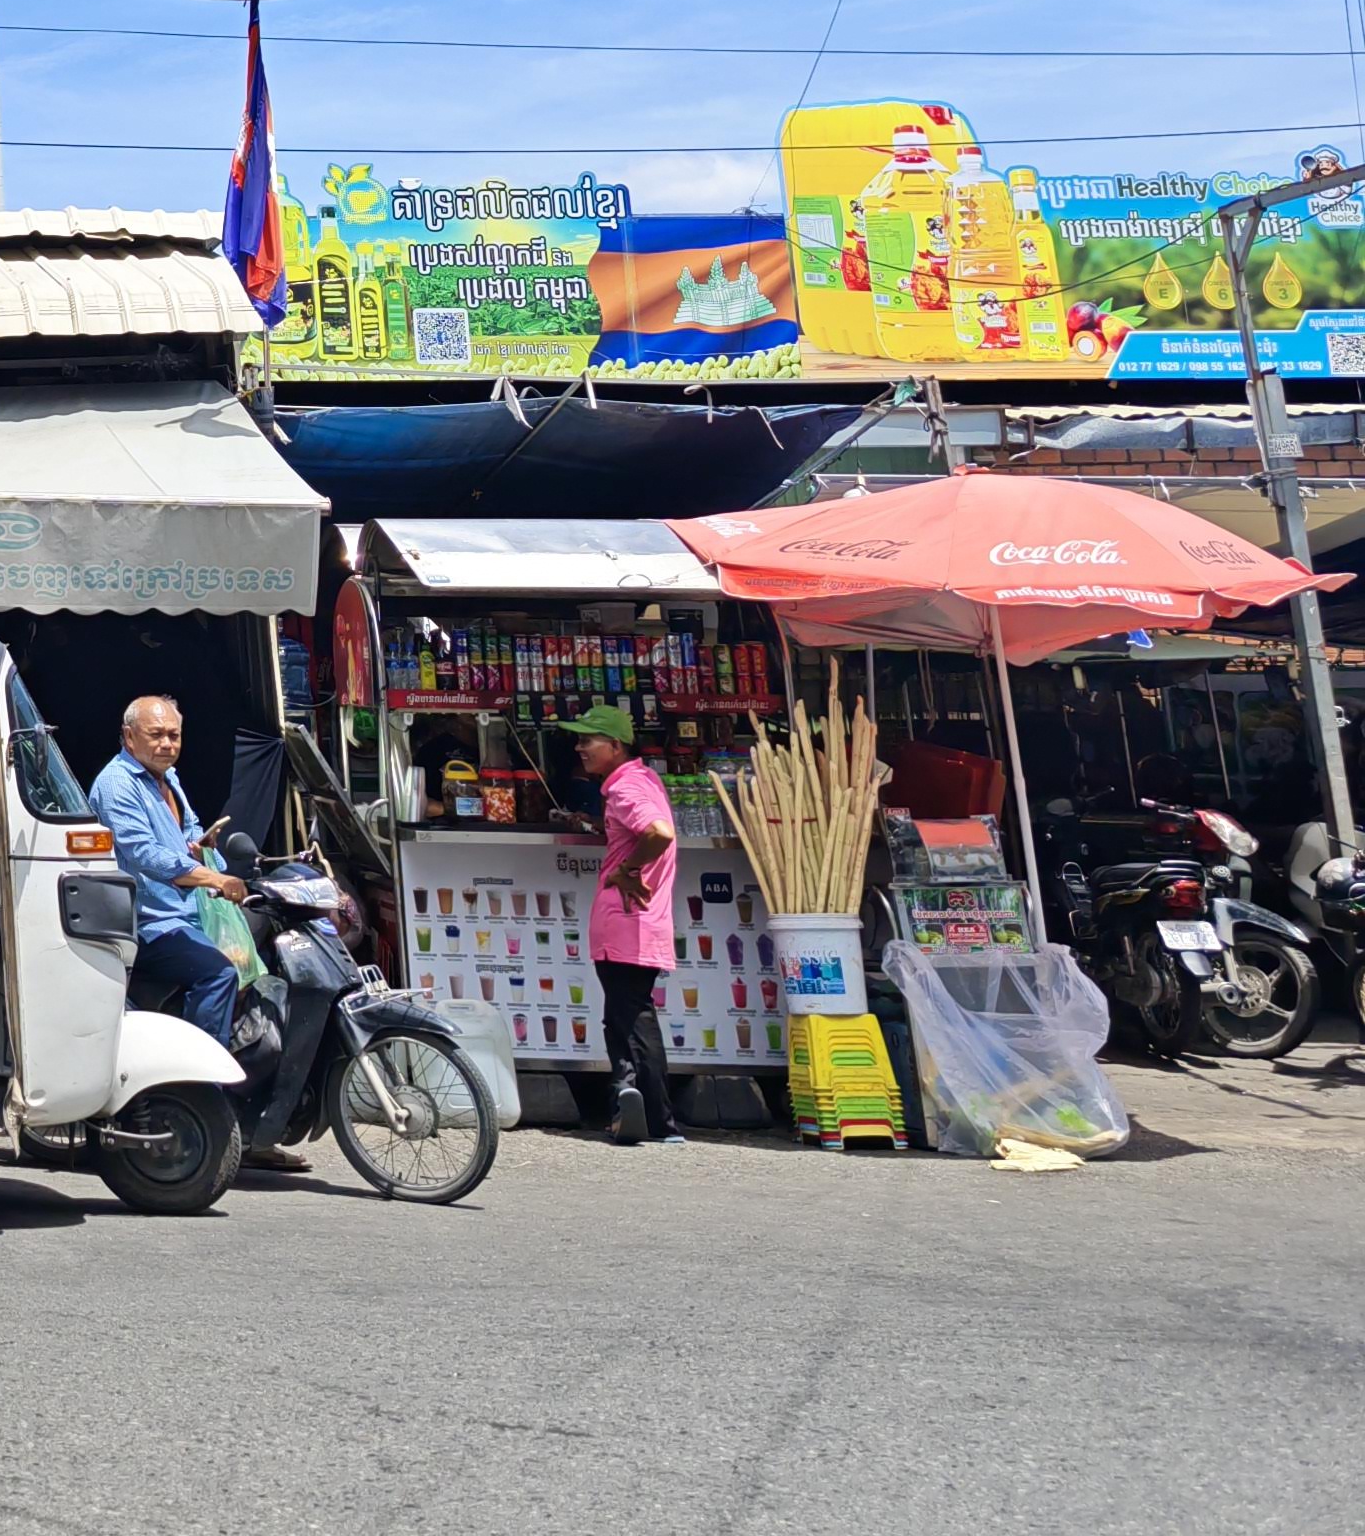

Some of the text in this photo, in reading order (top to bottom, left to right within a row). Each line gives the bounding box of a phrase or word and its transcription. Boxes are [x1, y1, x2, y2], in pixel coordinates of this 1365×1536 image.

[1118, 174, 1208, 202] Healthy
[1311, 200, 1358, 216] Healthy
[1321, 212, 1361, 225] Choice
[534, 277, 590, 314] កម្ពុជា
[1159, 289, 1169, 299] E
[1218, 289, 1228, 300] 6
[1276, 288, 1286, 300] 3
[1119, 361, 1138, 371] 012
[1140, 361, 1151, 371] 77
[1156, 361, 1179, 371] 1629
[1213, 361, 1223, 371] 55
[1282, 361, 1295, 371] 33
[1299, 361, 1322, 371] 1629
[778, 538, 916, 561] Coca-Cola
[988, 539, 1127, 565] Coca-Cola
[1178, 540, 1257, 565] Coca-Cola
[705, 883, 729, 893] ABA
